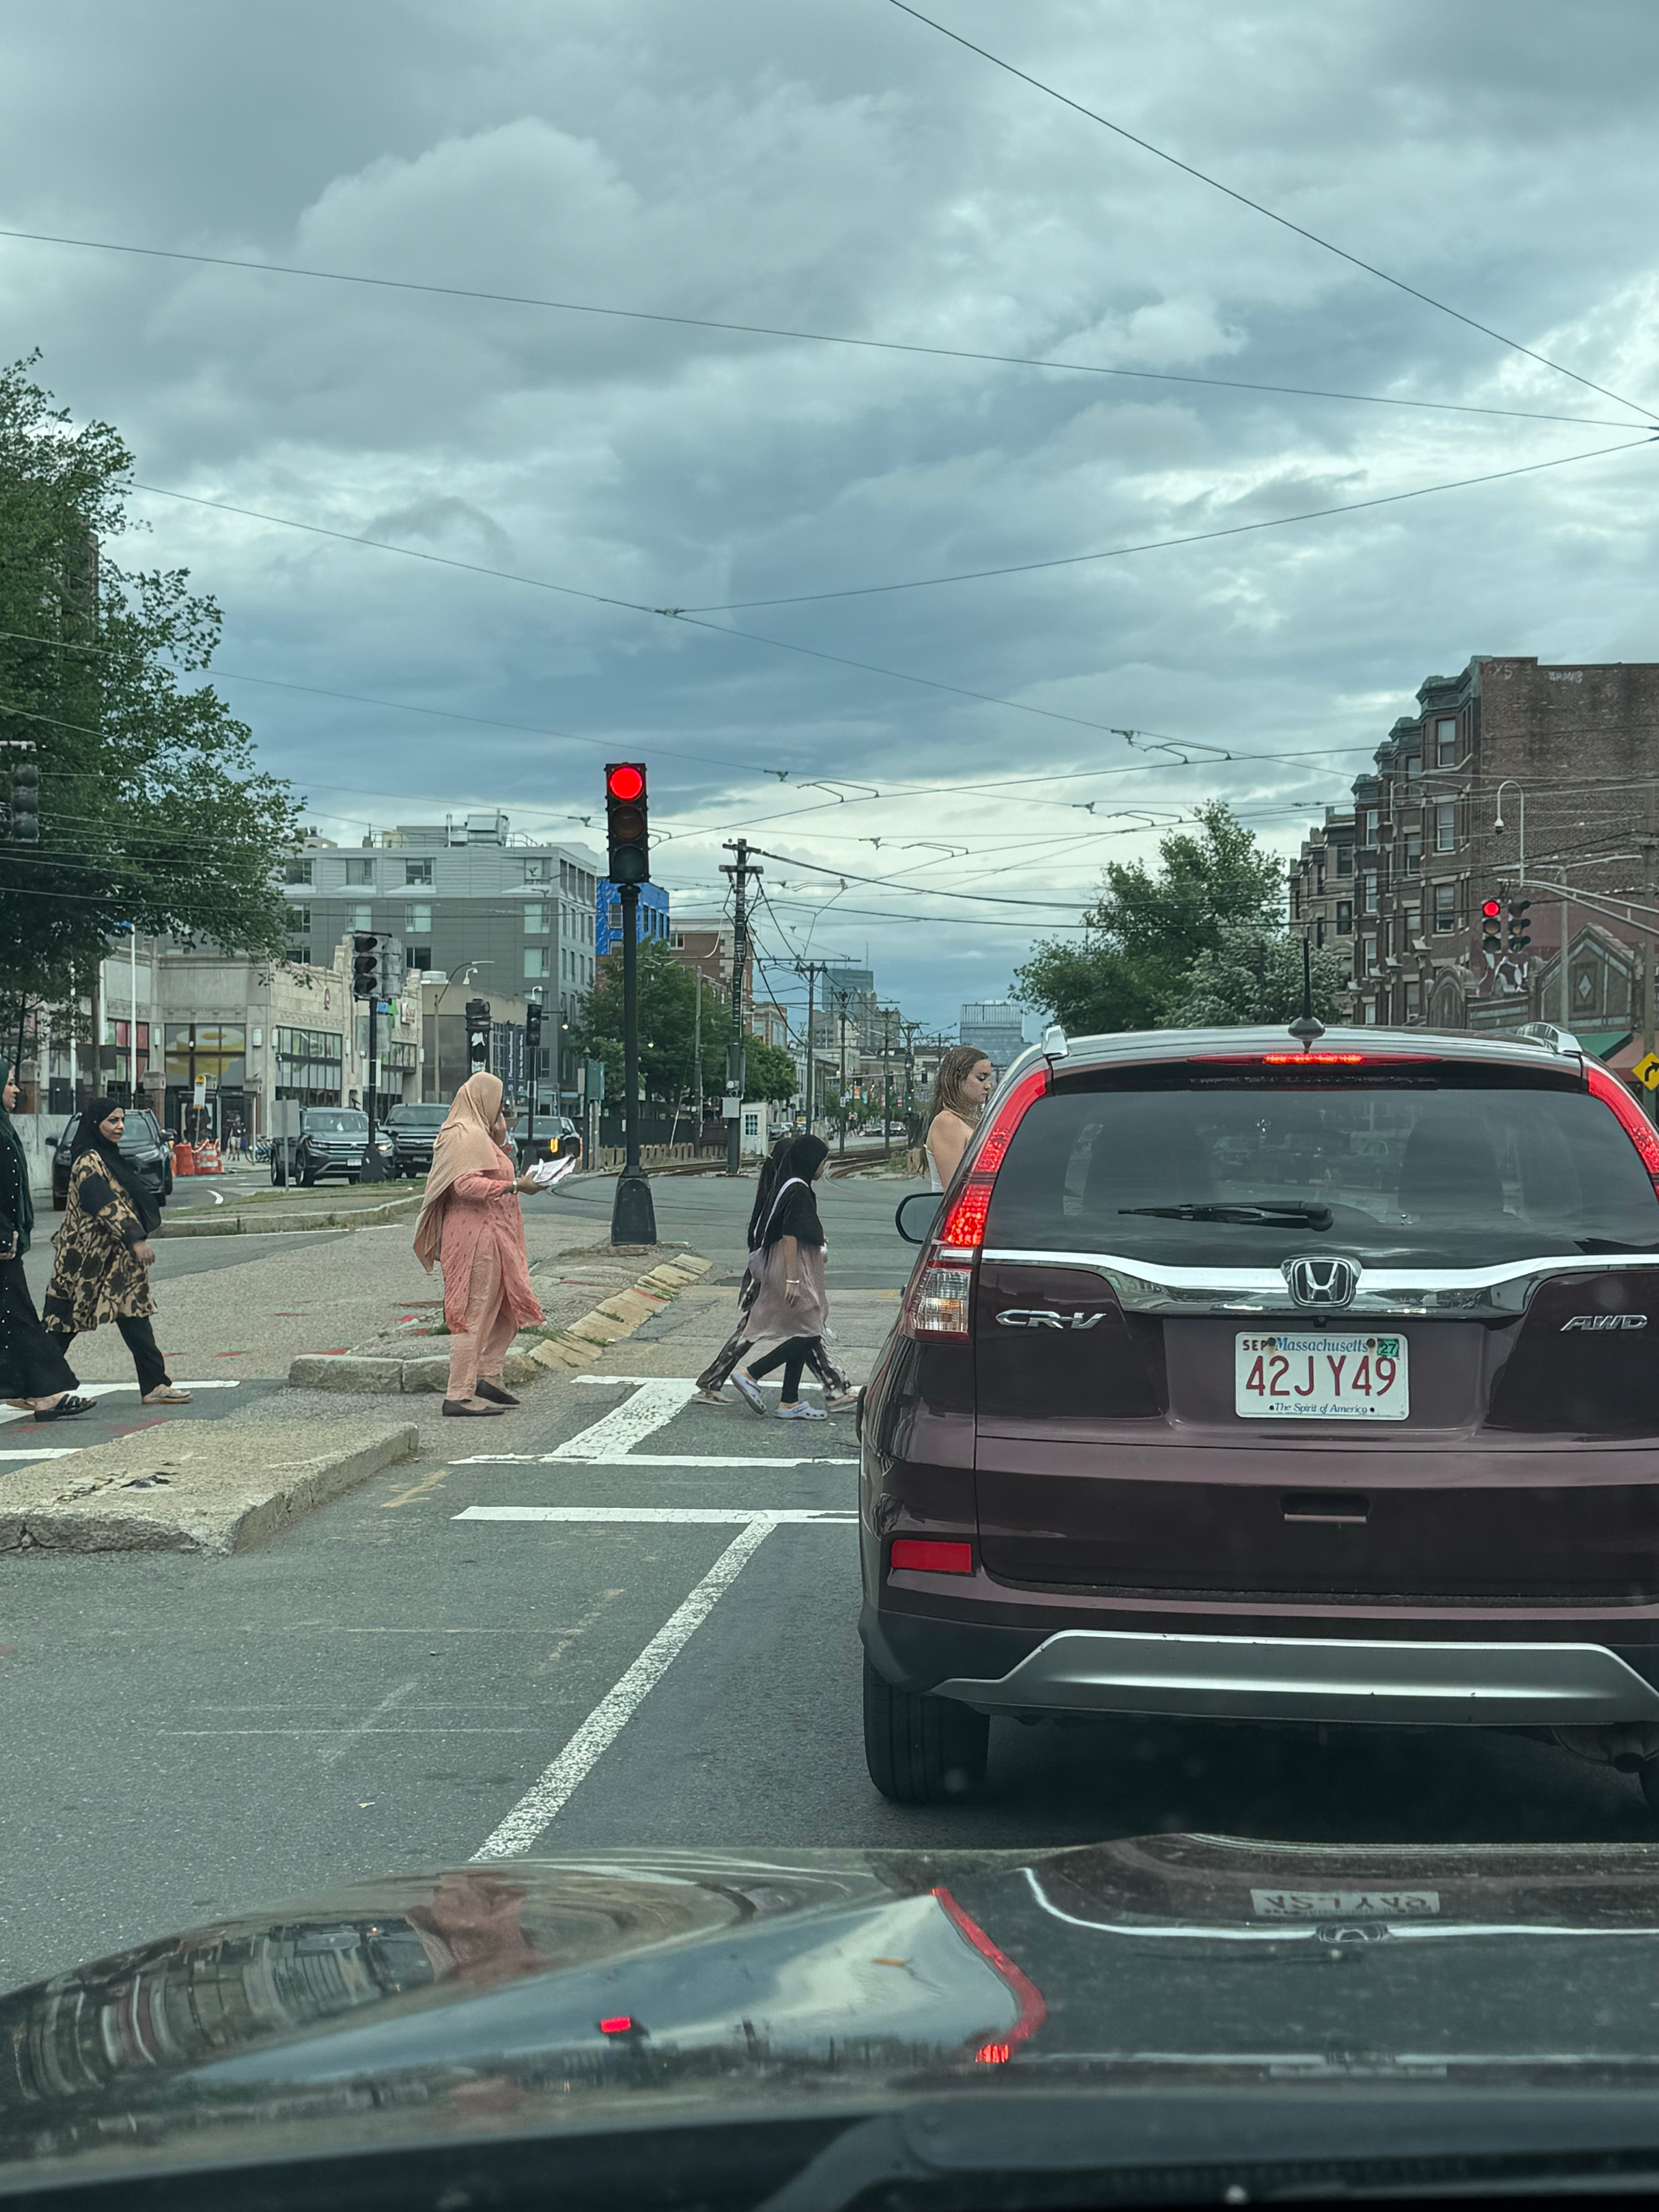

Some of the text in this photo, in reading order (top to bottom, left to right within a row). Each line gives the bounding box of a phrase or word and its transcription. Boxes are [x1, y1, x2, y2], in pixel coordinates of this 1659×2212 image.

[995, 1309, 1107, 1329] CR-V
[1560, 1314, 1648, 1331] AWD
[1242, 1340, 1268, 1351] SEP
[1275, 1337, 1368, 1352] Massachusetts
[1380, 1343, 1396, 1354] 27
[1275, 1403, 1367, 1414] The Spirit of America
